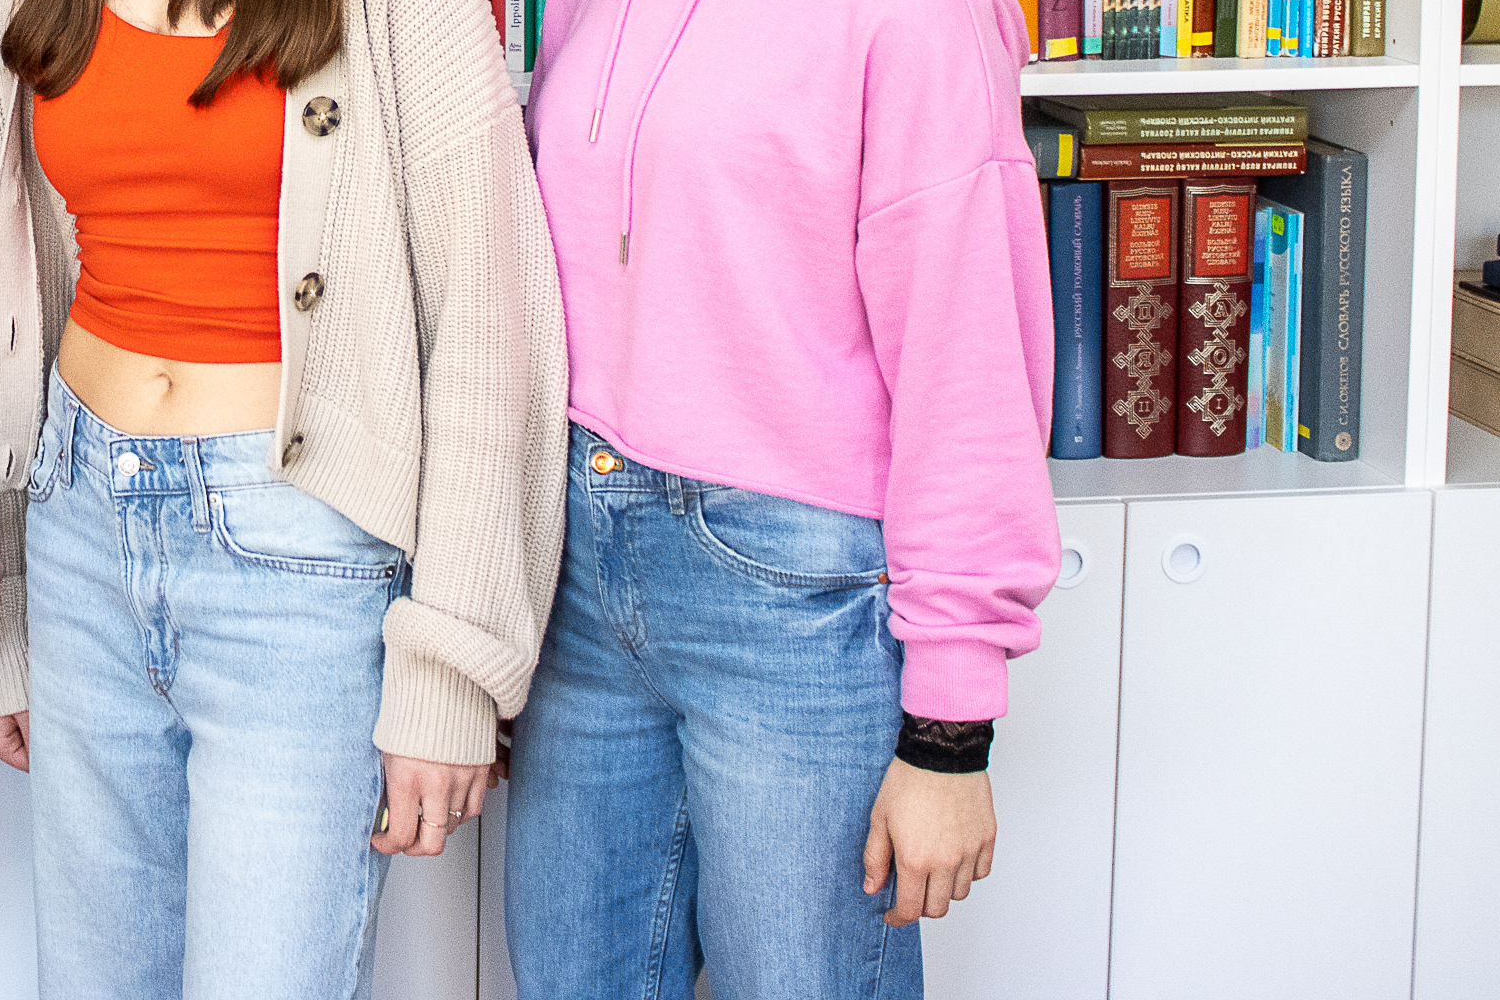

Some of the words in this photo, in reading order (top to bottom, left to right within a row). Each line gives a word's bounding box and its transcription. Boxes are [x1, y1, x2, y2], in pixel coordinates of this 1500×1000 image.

[1260, 116, 1294, 124] КРАТКИЙ
[1263, 150, 1298, 158] КРАТКИЙ
[1342, 166, 1354, 214] ЯЗЫКА
[1340, 215, 1352, 288] РУССКОГО
[1338, 290, 1350, 350] СЛОВАРЬ
